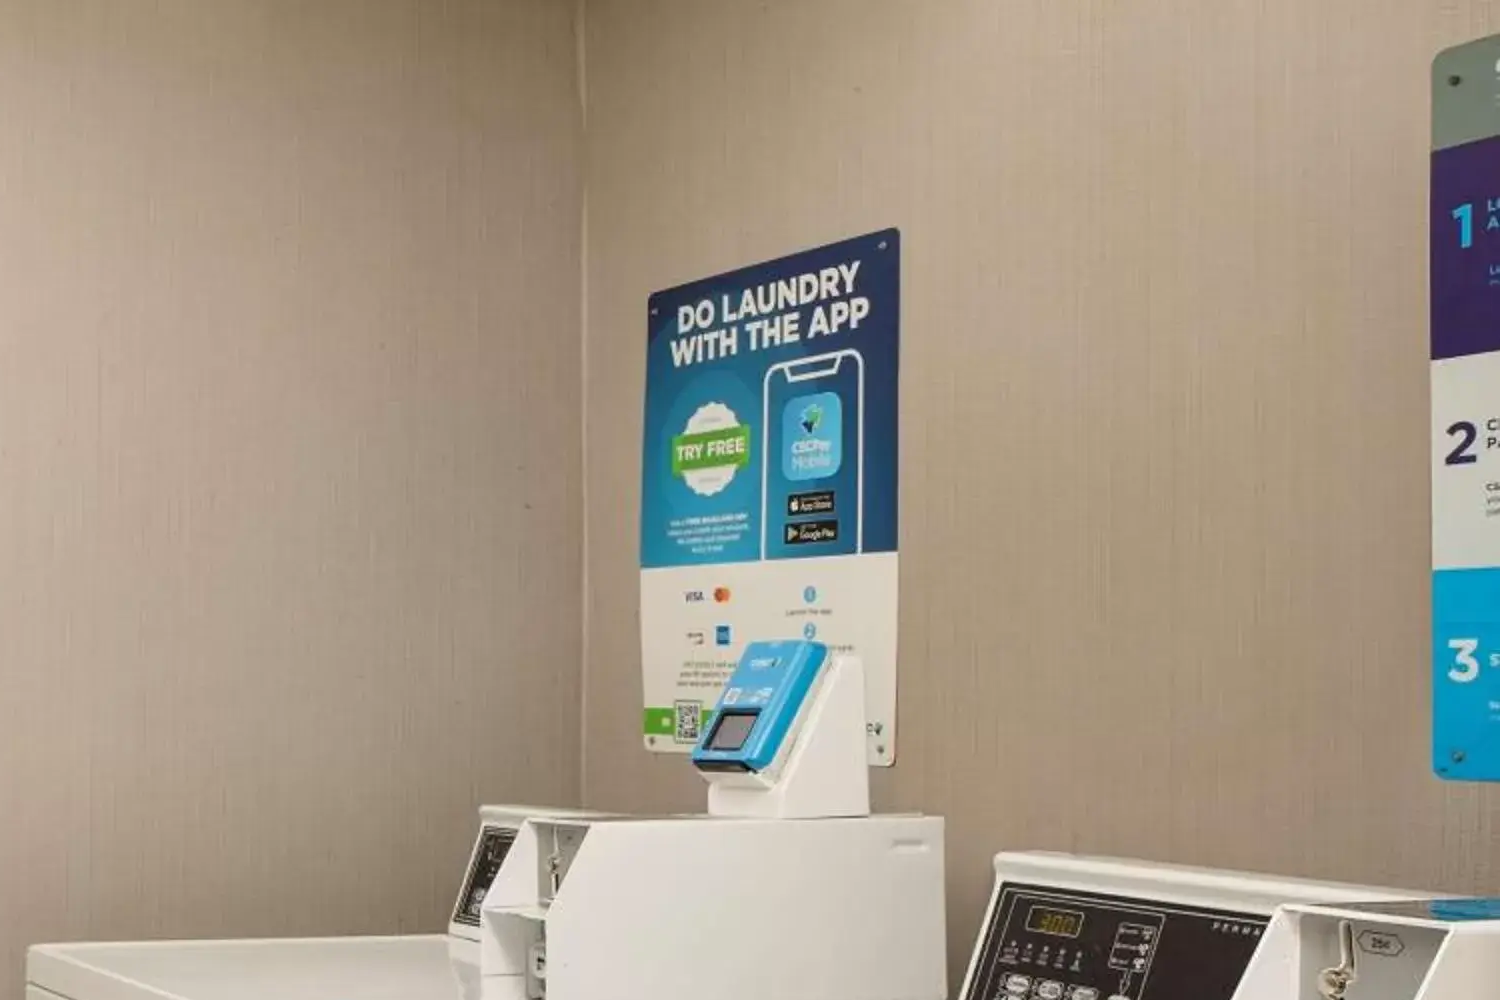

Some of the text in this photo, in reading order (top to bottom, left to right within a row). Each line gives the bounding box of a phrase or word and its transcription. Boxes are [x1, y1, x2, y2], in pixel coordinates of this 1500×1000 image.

[1451, 203, 1472, 249] 1
[677, 260, 862, 334] DO LAUNDRY
[670, 296, 870, 368] WITH THE APP
[676, 436, 746, 462] TRY FREE
[1445, 421, 1477, 465] 2
[1448, 639, 1478, 682] 3
